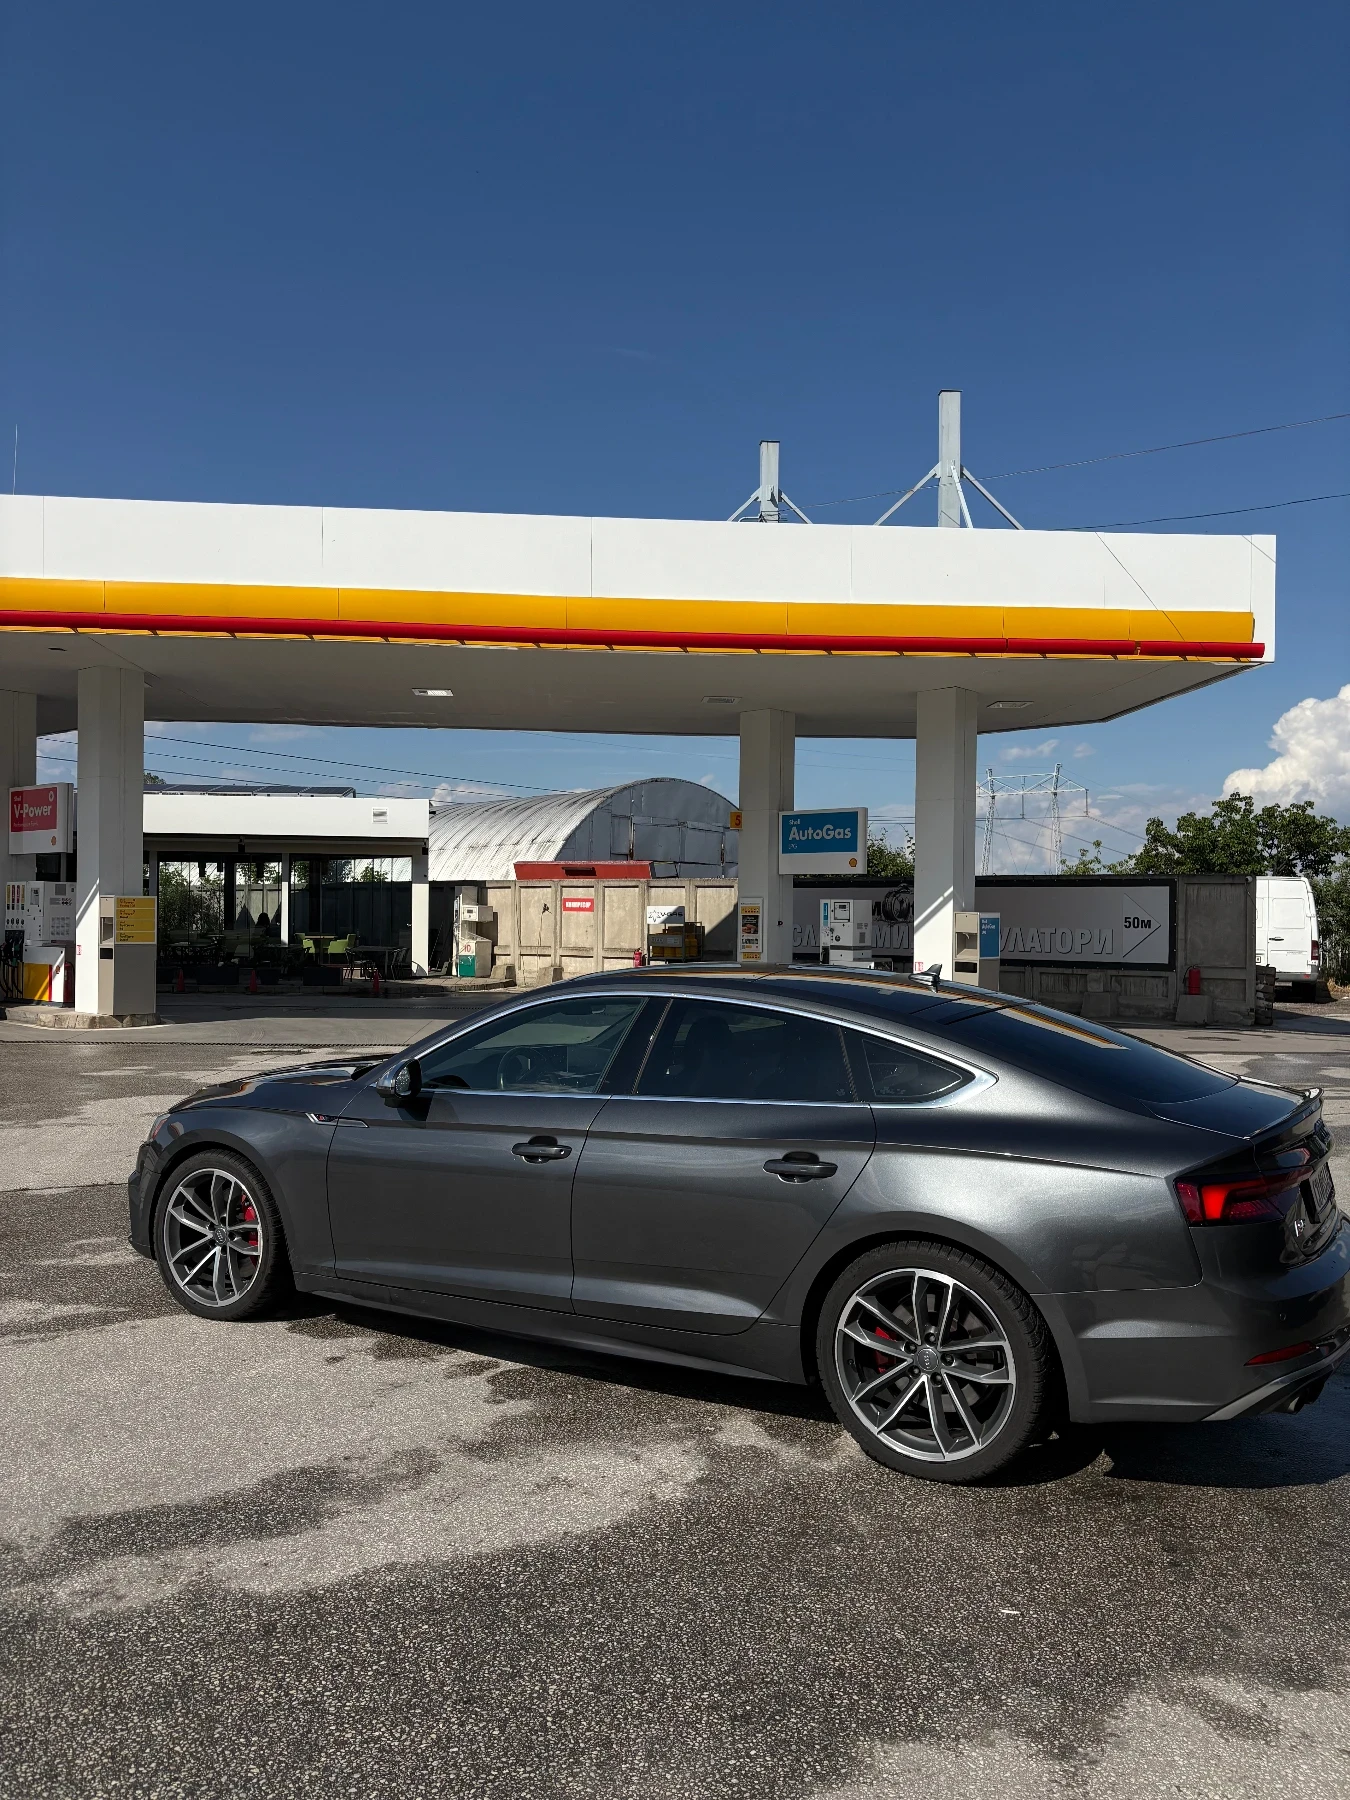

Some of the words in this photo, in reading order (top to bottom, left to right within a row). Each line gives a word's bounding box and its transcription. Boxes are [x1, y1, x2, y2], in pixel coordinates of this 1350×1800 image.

[13, 803, 52, 818] V-Power
[734, 814, 741, 827] 5
[788, 818, 801, 826] Shell
[788, 824, 852, 841] AutoGas
[1123, 916, 1152, 930] 50м
[1000, 926, 1114, 955] УЛАТОРИ
